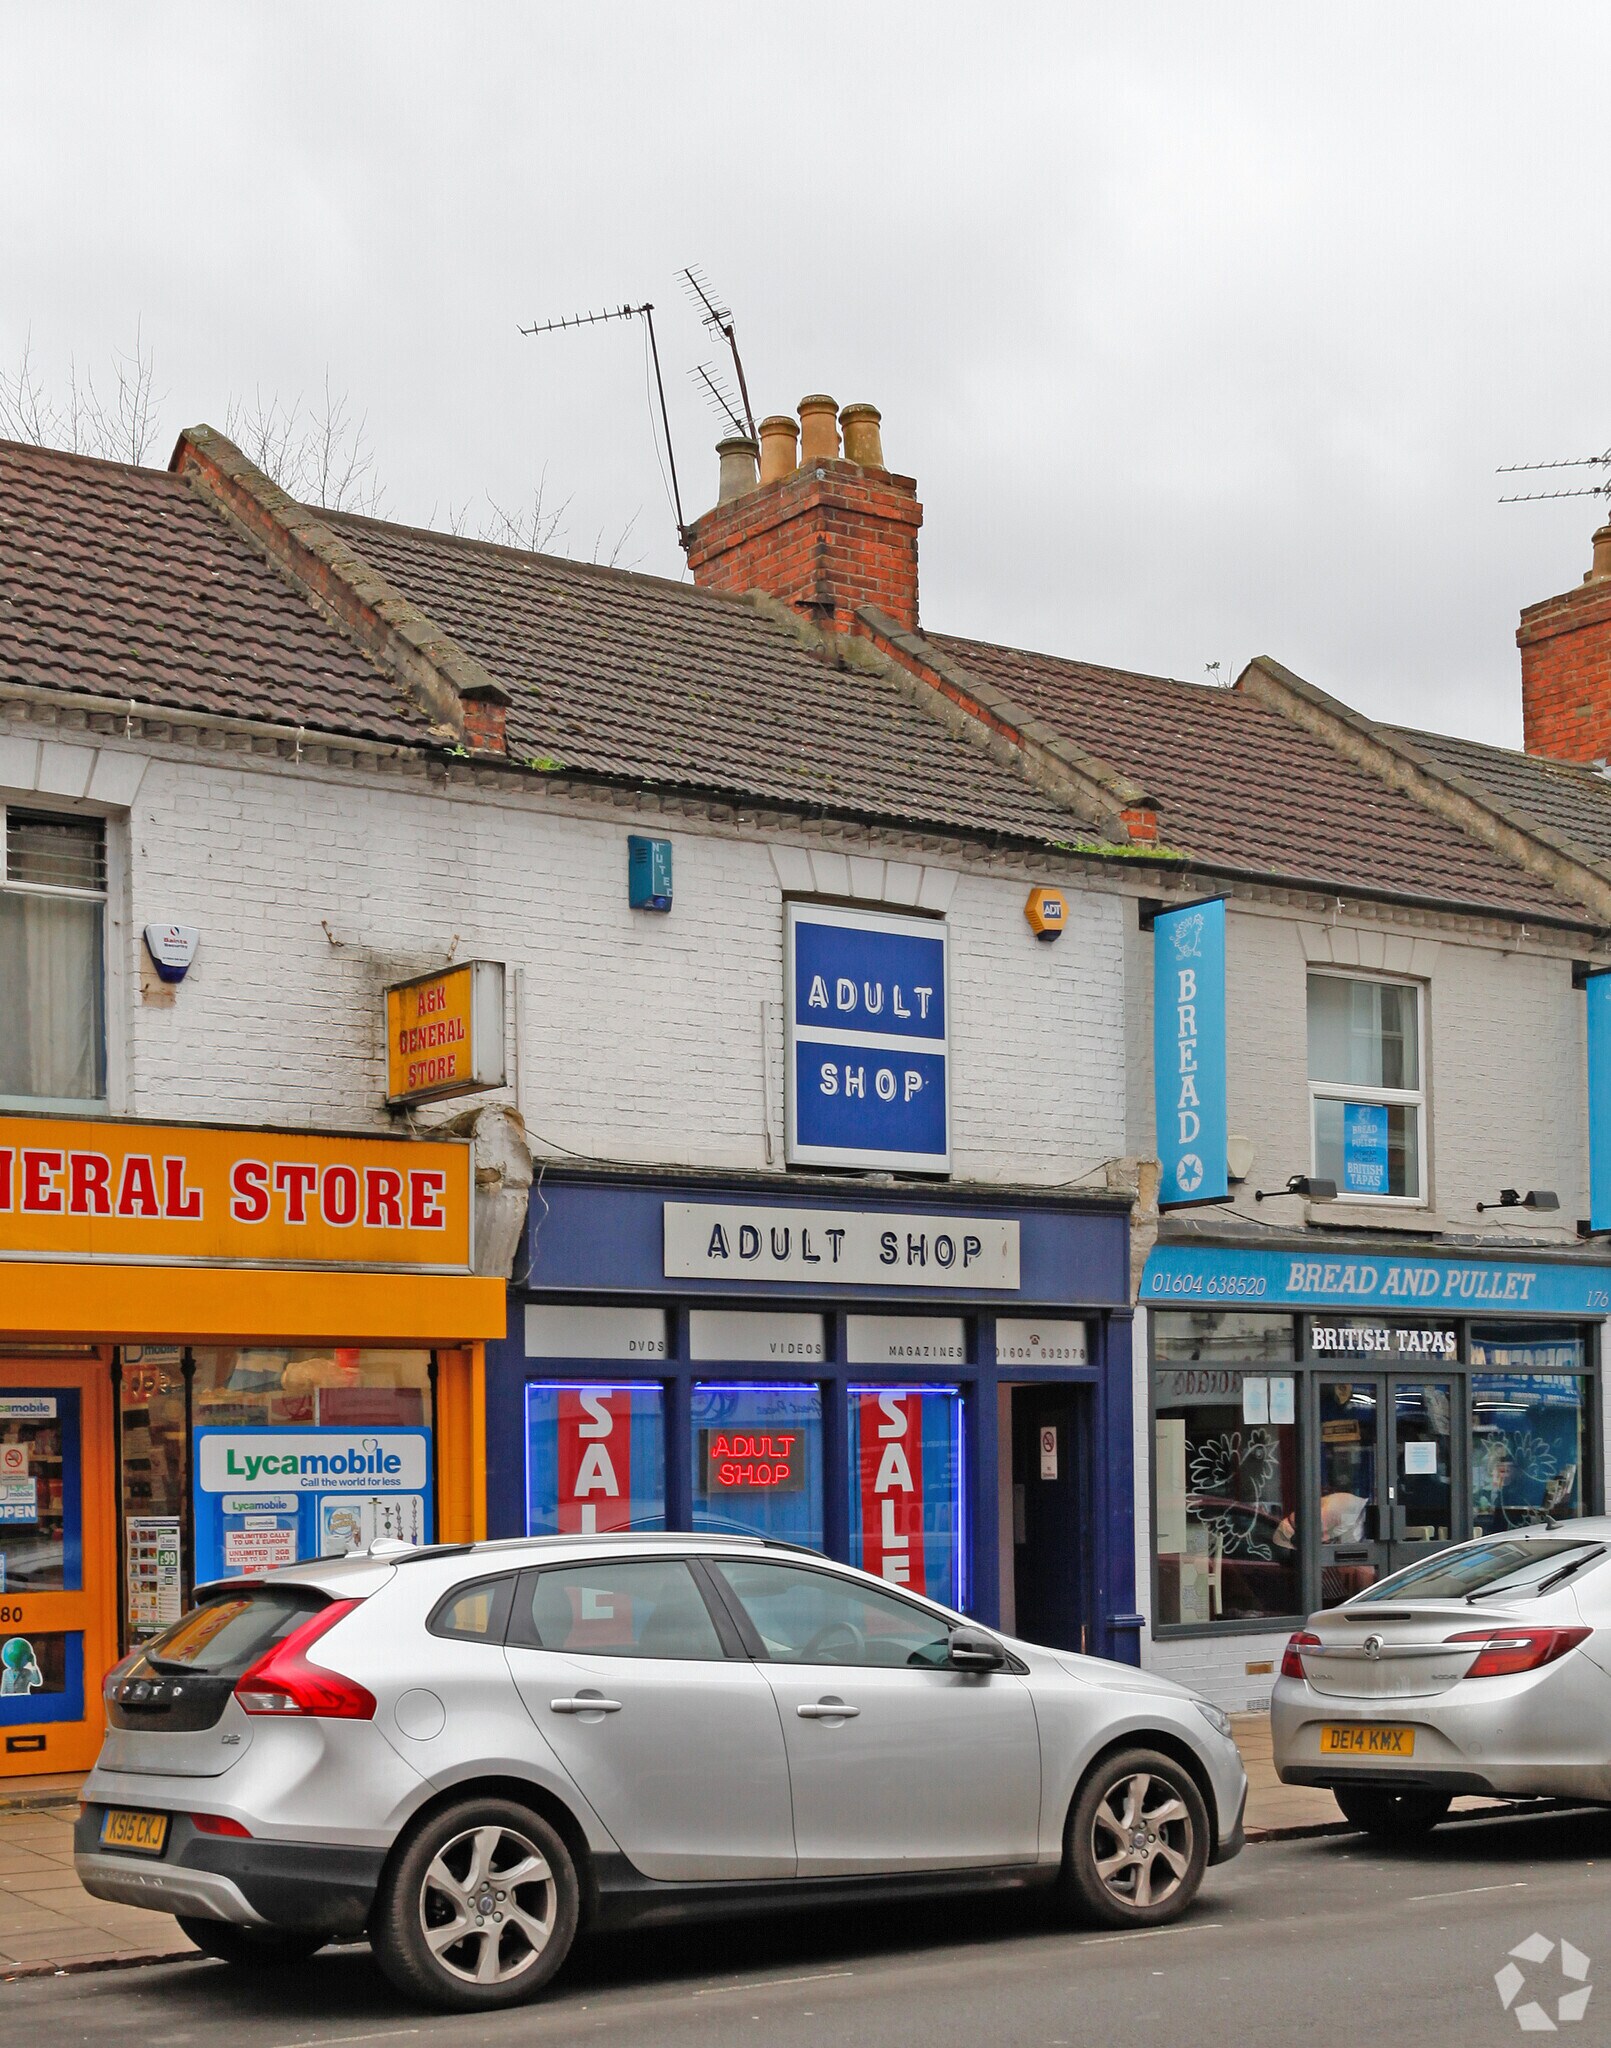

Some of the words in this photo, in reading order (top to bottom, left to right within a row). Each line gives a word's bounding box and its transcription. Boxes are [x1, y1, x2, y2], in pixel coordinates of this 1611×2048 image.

[1044, 904, 1061, 916] ADT
[417, 985, 446, 1016] A&K
[808, 975, 932, 1019] ADULT
[399, 1017, 465, 1055] GENERAL
[1177, 969, 1200, 1144] BREAD
[408, 1054, 456, 1088] STORE
[819, 1062, 923, 1102] SHOP
[1347, 1162, 1384, 1176] BRITISH
[1350, 1173, 1381, 1186] TAPAS
[230, 1158, 446, 1231] STORE
[707, 1223, 845, 1265] ADULT
[879, 1231, 982, 1269] SHOP
[1152, 1273, 1203, 1293] 01604
[1206, 1275, 1267, 1296] 638520
[1286, 1262, 1378, 1294] BREAD
[1380, 1268, 1440, 1296] AND
[1442, 1270, 1536, 1300] PULLET
[1586, 1290, 1609, 1308] 176
[629, 1340, 665, 1352] DVDS
[769, 1342, 822, 1355] VIDEOS
[889, 1346, 963, 1357] MAGAZINES
[1311, 1327, 1391, 1351] BRITISH
[1396, 1330, 1456, 1353] TAPAS
[712, 1435, 795, 1459] ADULT
[227, 1447, 401, 1481] Lycamobile
[718, 1462, 791, 1486] SHOP
[300, 1478, 320, 1487] Call
[321, 1478, 338, 1487] the
[338, 1478, 366, 1486] world
[367, 1478, 381, 1486] for
[382, 1478, 401, 1486] less
[232, 1501, 287, 1511] Lycamobile
[160, 1551, 176, 1565] £99
[1330, 1730, 1364, 1749] DE14
[1369, 1730, 1404, 1751] KMX
[109, 1812, 137, 1841] KS15
[137, 1815, 164, 1844] CKJ
